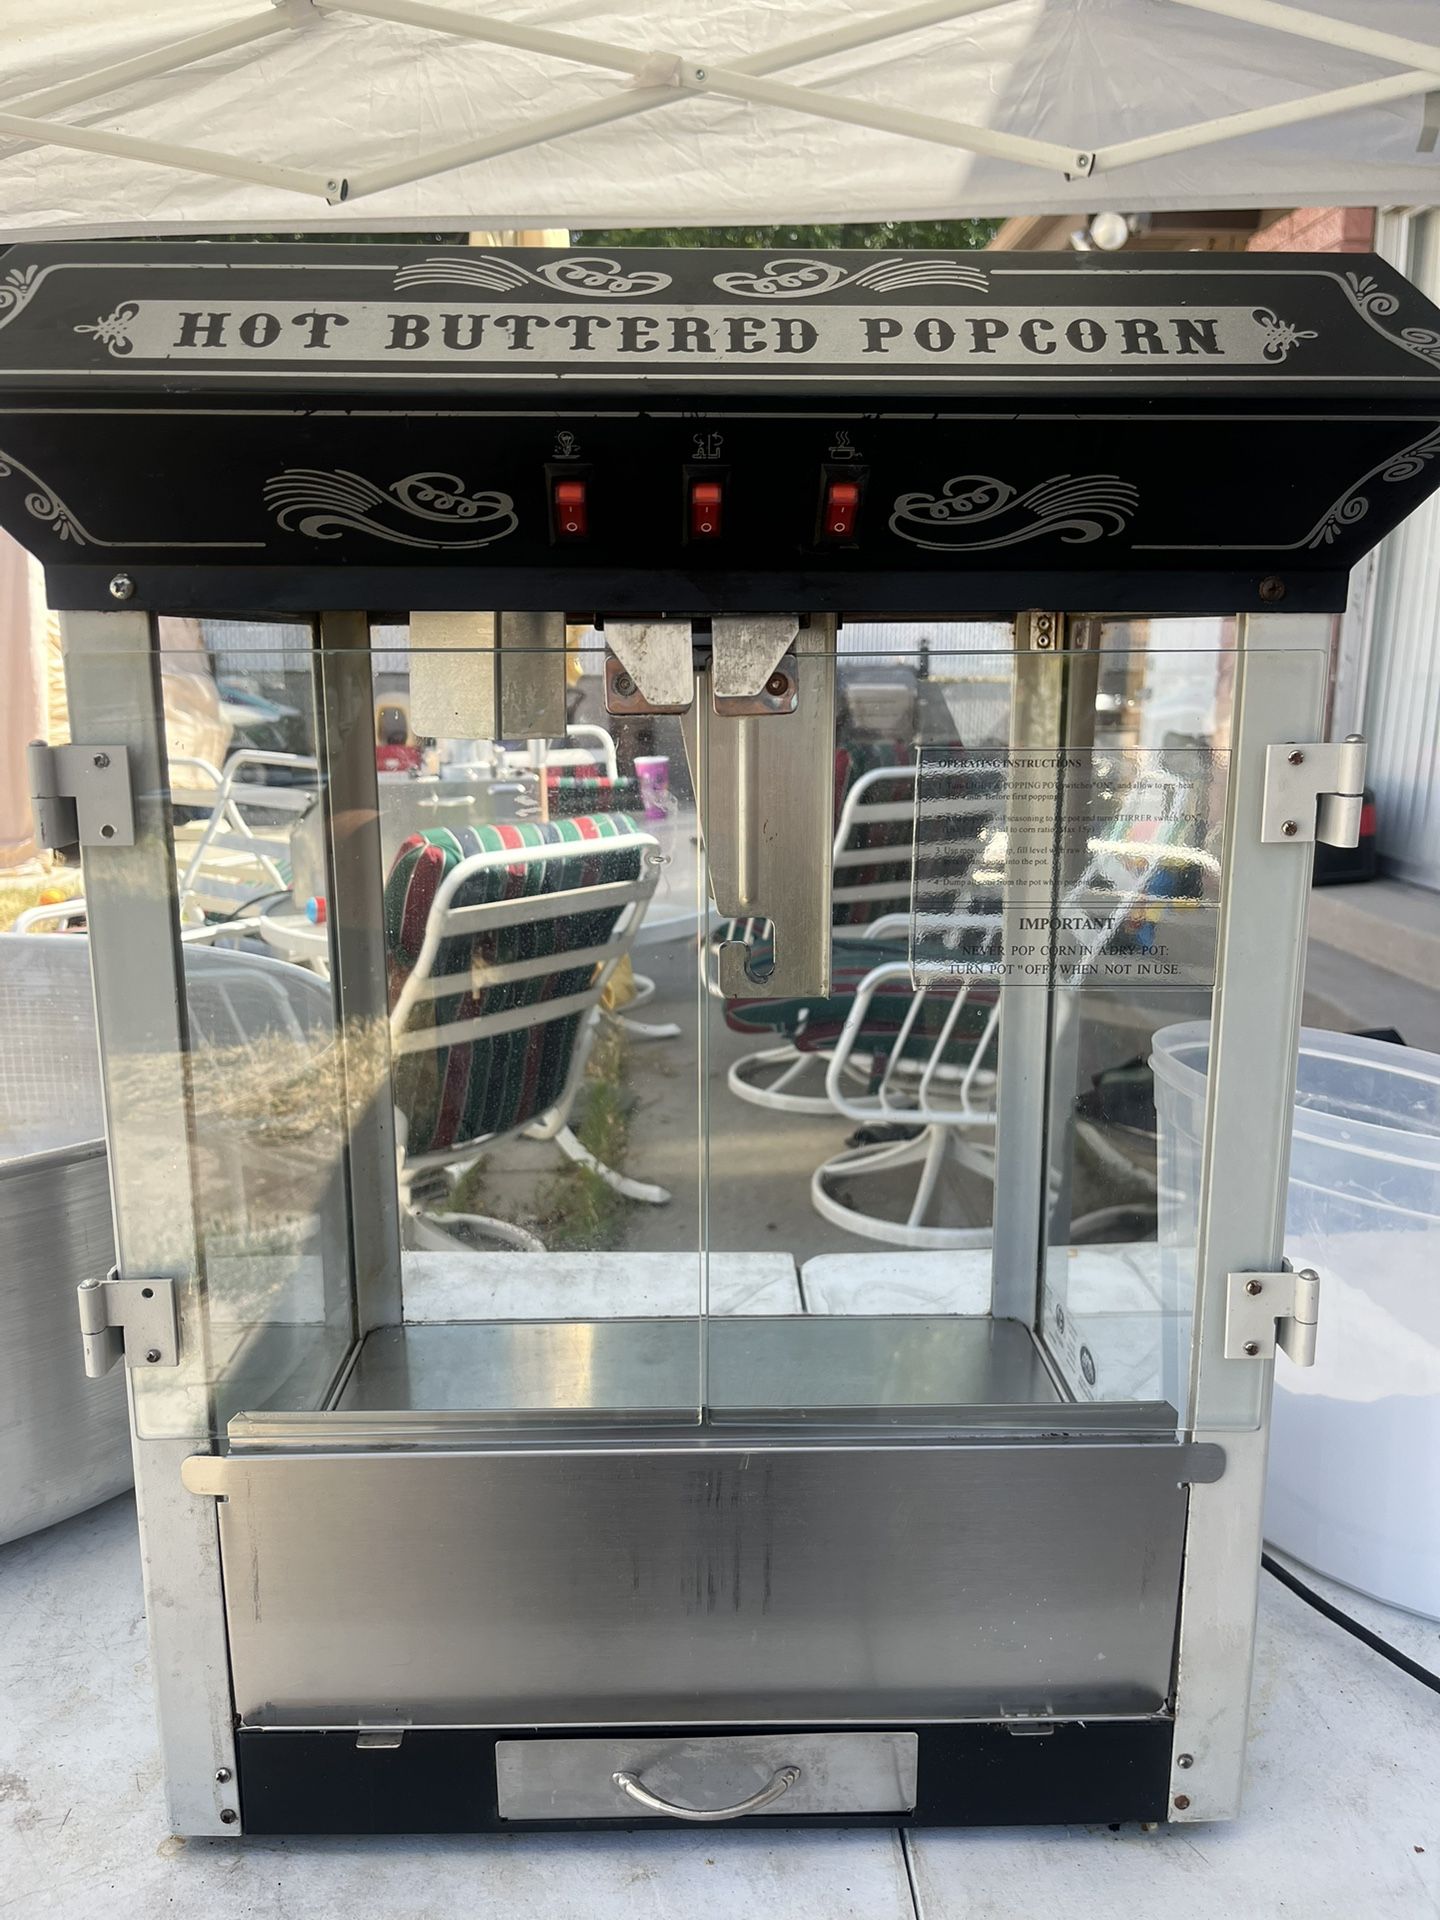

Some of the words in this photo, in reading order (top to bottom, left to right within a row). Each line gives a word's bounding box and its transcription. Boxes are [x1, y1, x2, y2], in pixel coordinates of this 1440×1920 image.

[173, 311, 350, 350] HOT
[384, 312, 820, 354] BUTTERED
[859, 317, 1226, 355] POPCORN
[938, 759, 1001, 768] OPERATING
[1003, 759, 1082, 768] INSTRUCTIONS
[1003, 781, 1041, 789] POPPING
[1118, 780, 1131, 789] and
[1133, 779, 1153, 789] allow
[1068, 814, 1081, 824] pot
[1083, 813, 1096, 822] and
[1114, 814, 1152, 822] STIRRER
[1009, 825, 1019, 833] to
[1017, 846, 1028, 854] fill
[1029, 846, 1048, 854] level
[1021, 857, 1034, 865] the
[1034, 858, 1049, 868] pot.
[1016, 878, 1028, 886] the
[1029, 879, 1042, 889] pot
[1019, 917, 1115, 931] IMPORTANT
[963, 945, 1004, 956] NEVER
[1011, 945, 1035, 956] POP
[1040, 945, 1076, 957] CORN
[1079, 945, 1092, 956] IN
[1097, 946, 1109, 956] A
[949, 964, 983, 975] TURN
[989, 964, 1015, 975] POT
[1060, 964, 1098, 975] WHEN
[1104, 964, 1132, 975] NOT
[1137, 964, 1150, 975] IN
[1152, 964, 1182, 976] USE.
